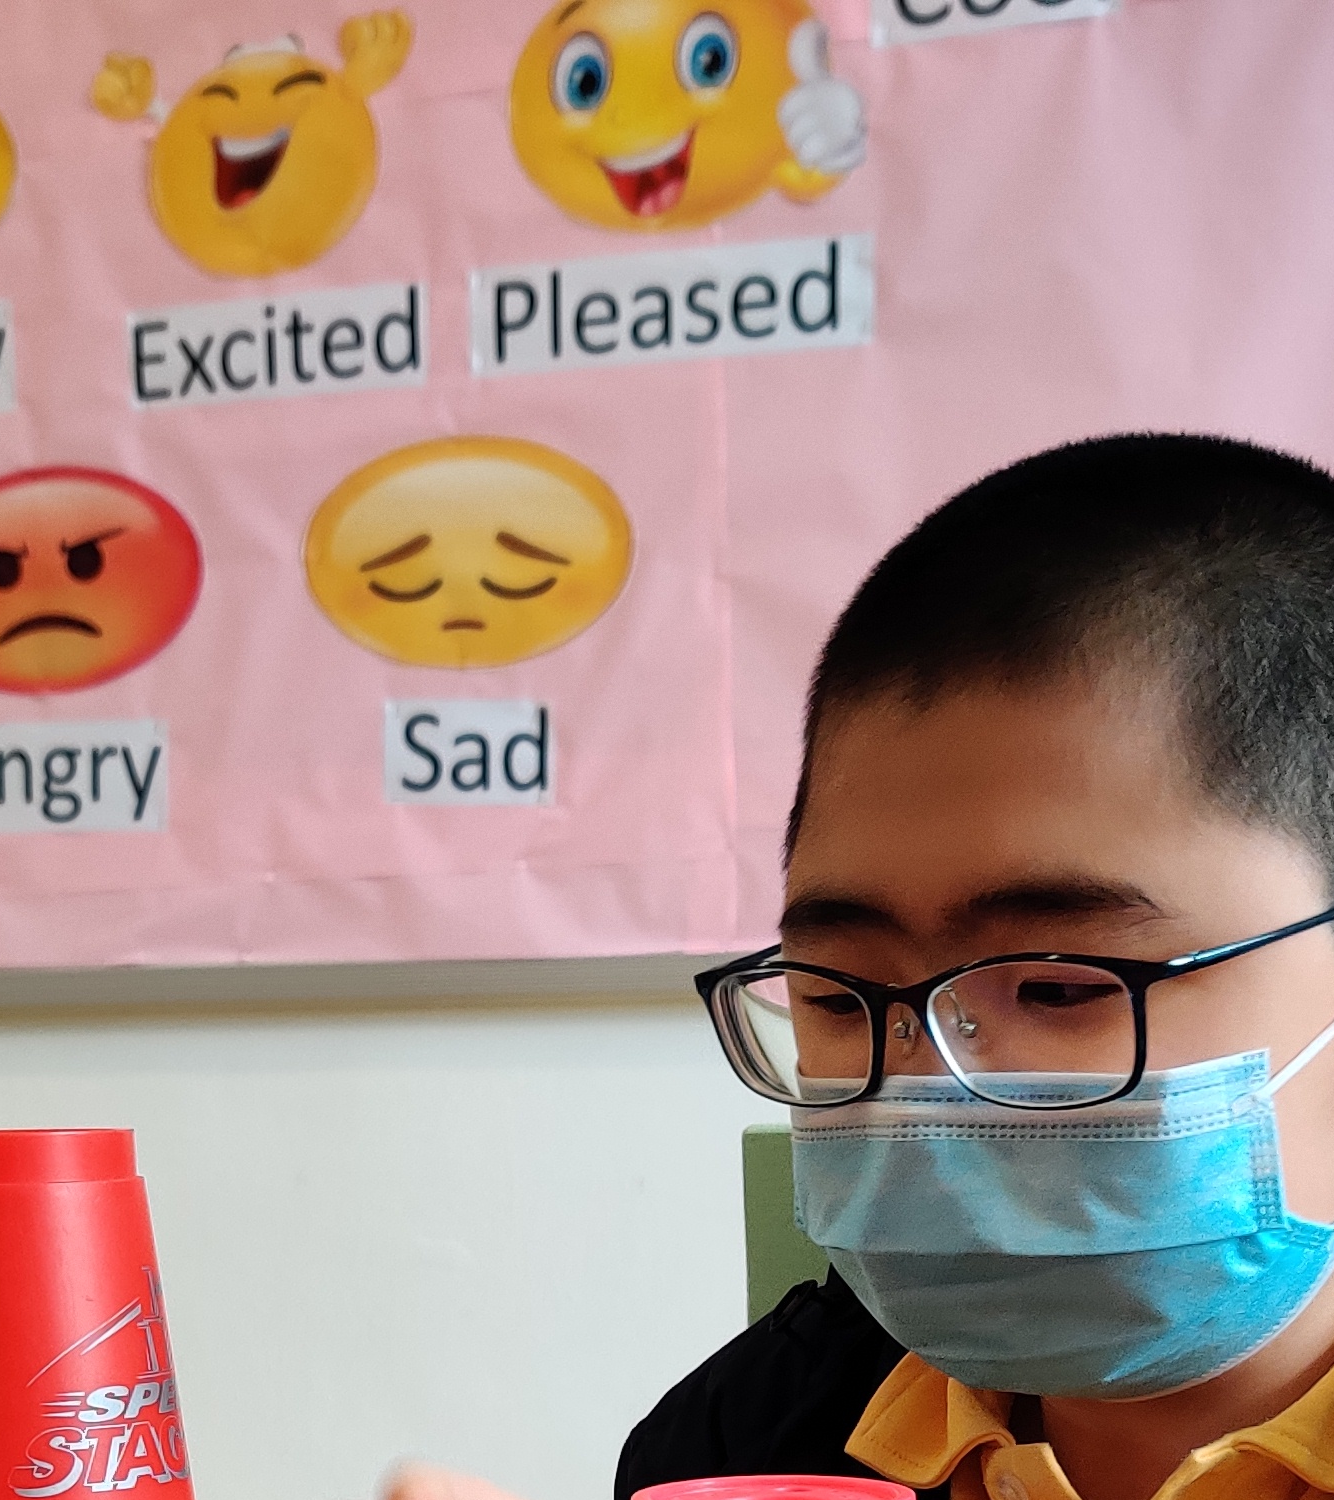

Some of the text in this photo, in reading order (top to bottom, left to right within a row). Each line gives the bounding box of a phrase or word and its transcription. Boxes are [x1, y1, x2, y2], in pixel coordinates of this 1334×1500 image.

[132, 285, 422, 402] Excited
[492, 240, 844, 365] Pleased
[398, 706, 550, 793] Sad
[77, 1379, 176, 1423] SPE
[7, 1415, 190, 1498] STAC
